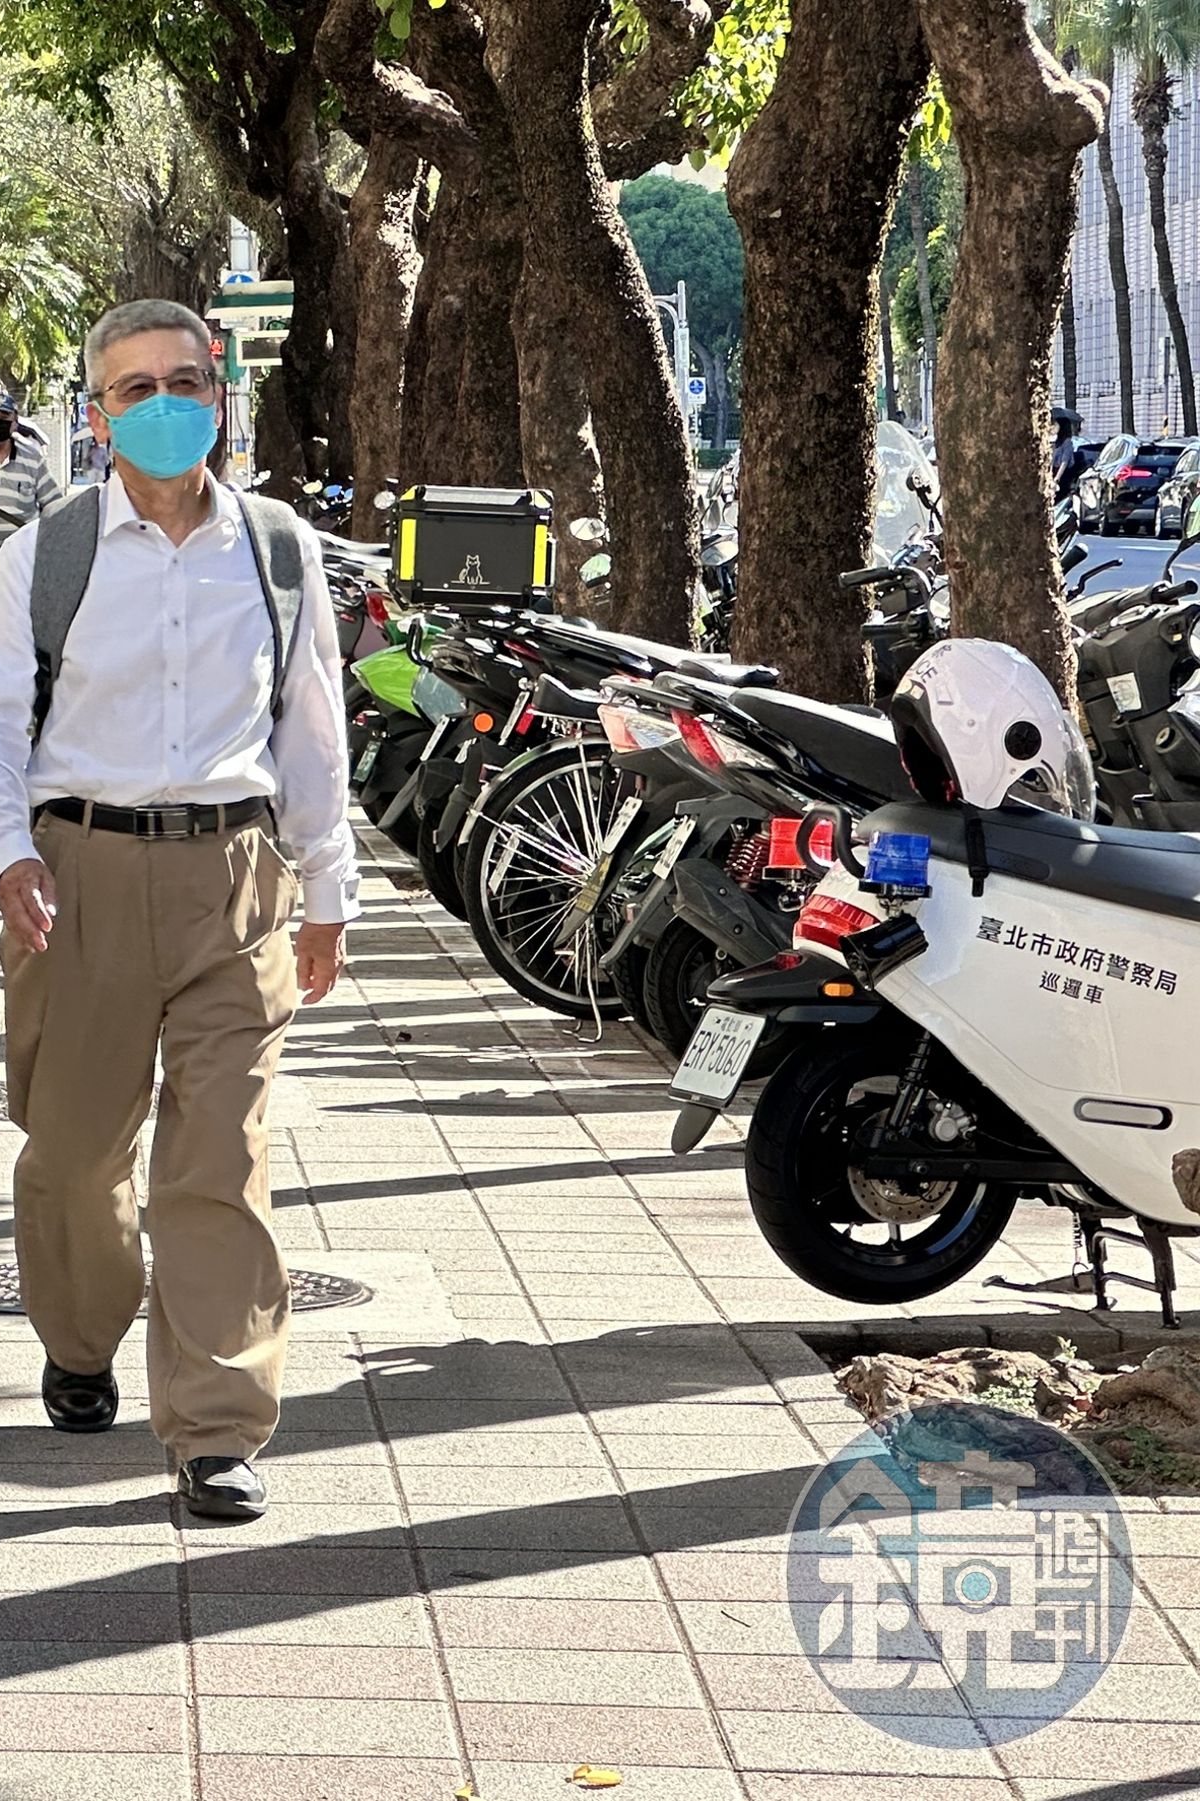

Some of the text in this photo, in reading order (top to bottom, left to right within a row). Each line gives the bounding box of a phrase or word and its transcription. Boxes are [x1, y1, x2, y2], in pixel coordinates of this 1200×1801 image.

[976, 915, 1178, 995] 臺北市政府警察局
[1038, 970, 1104, 1004] 巡邏車
